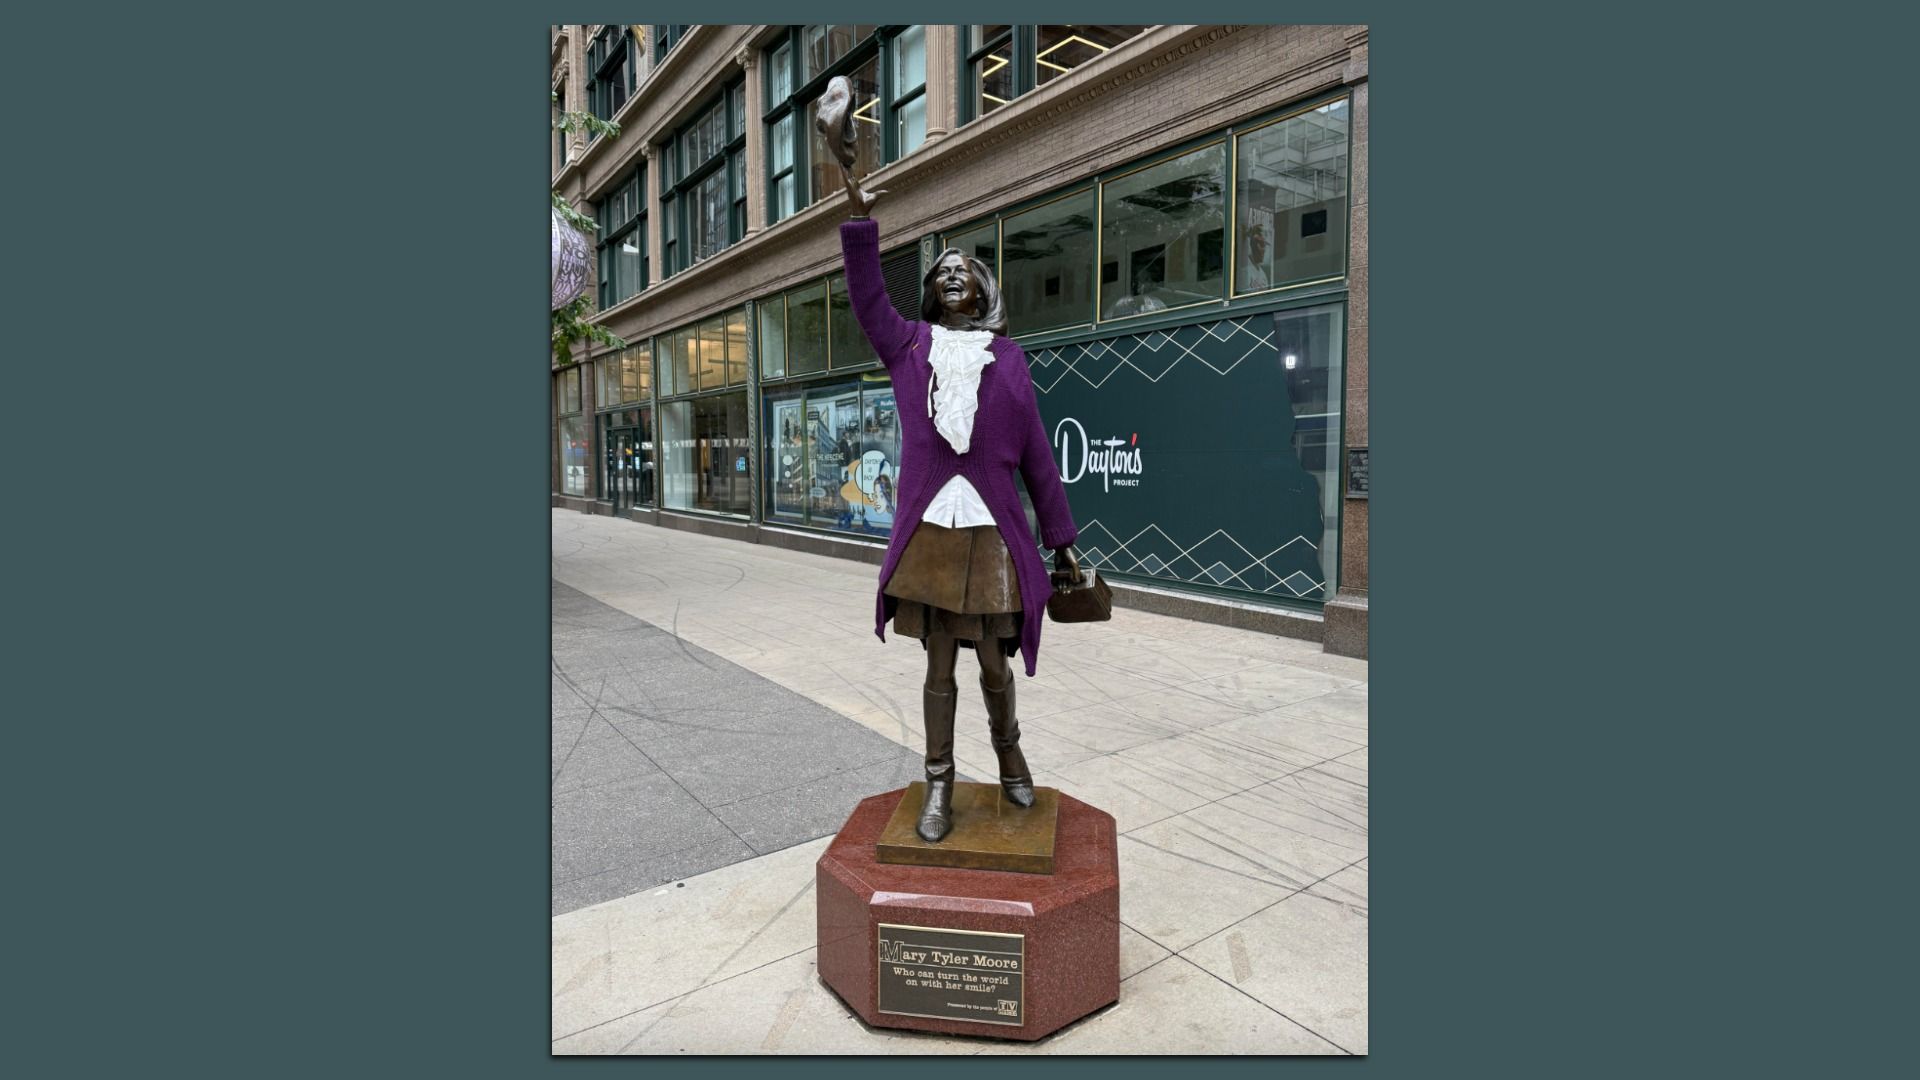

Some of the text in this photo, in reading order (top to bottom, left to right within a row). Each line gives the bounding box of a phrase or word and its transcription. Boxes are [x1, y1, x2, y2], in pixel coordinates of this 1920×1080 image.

[1055, 417, 1142, 493] Dayton's
[880, 940, 1018, 969] Mary Tyler Moore
[893, 967, 915, 977] Who
[937, 972, 959, 981] turn
[962, 974, 978, 982] the
[981, 976, 1009, 985] world
[921, 980, 942, 989] with
[945, 981, 962, 990] her
[964, 984, 996, 993] smile?
[1000, 1001, 1016, 1010] TV
